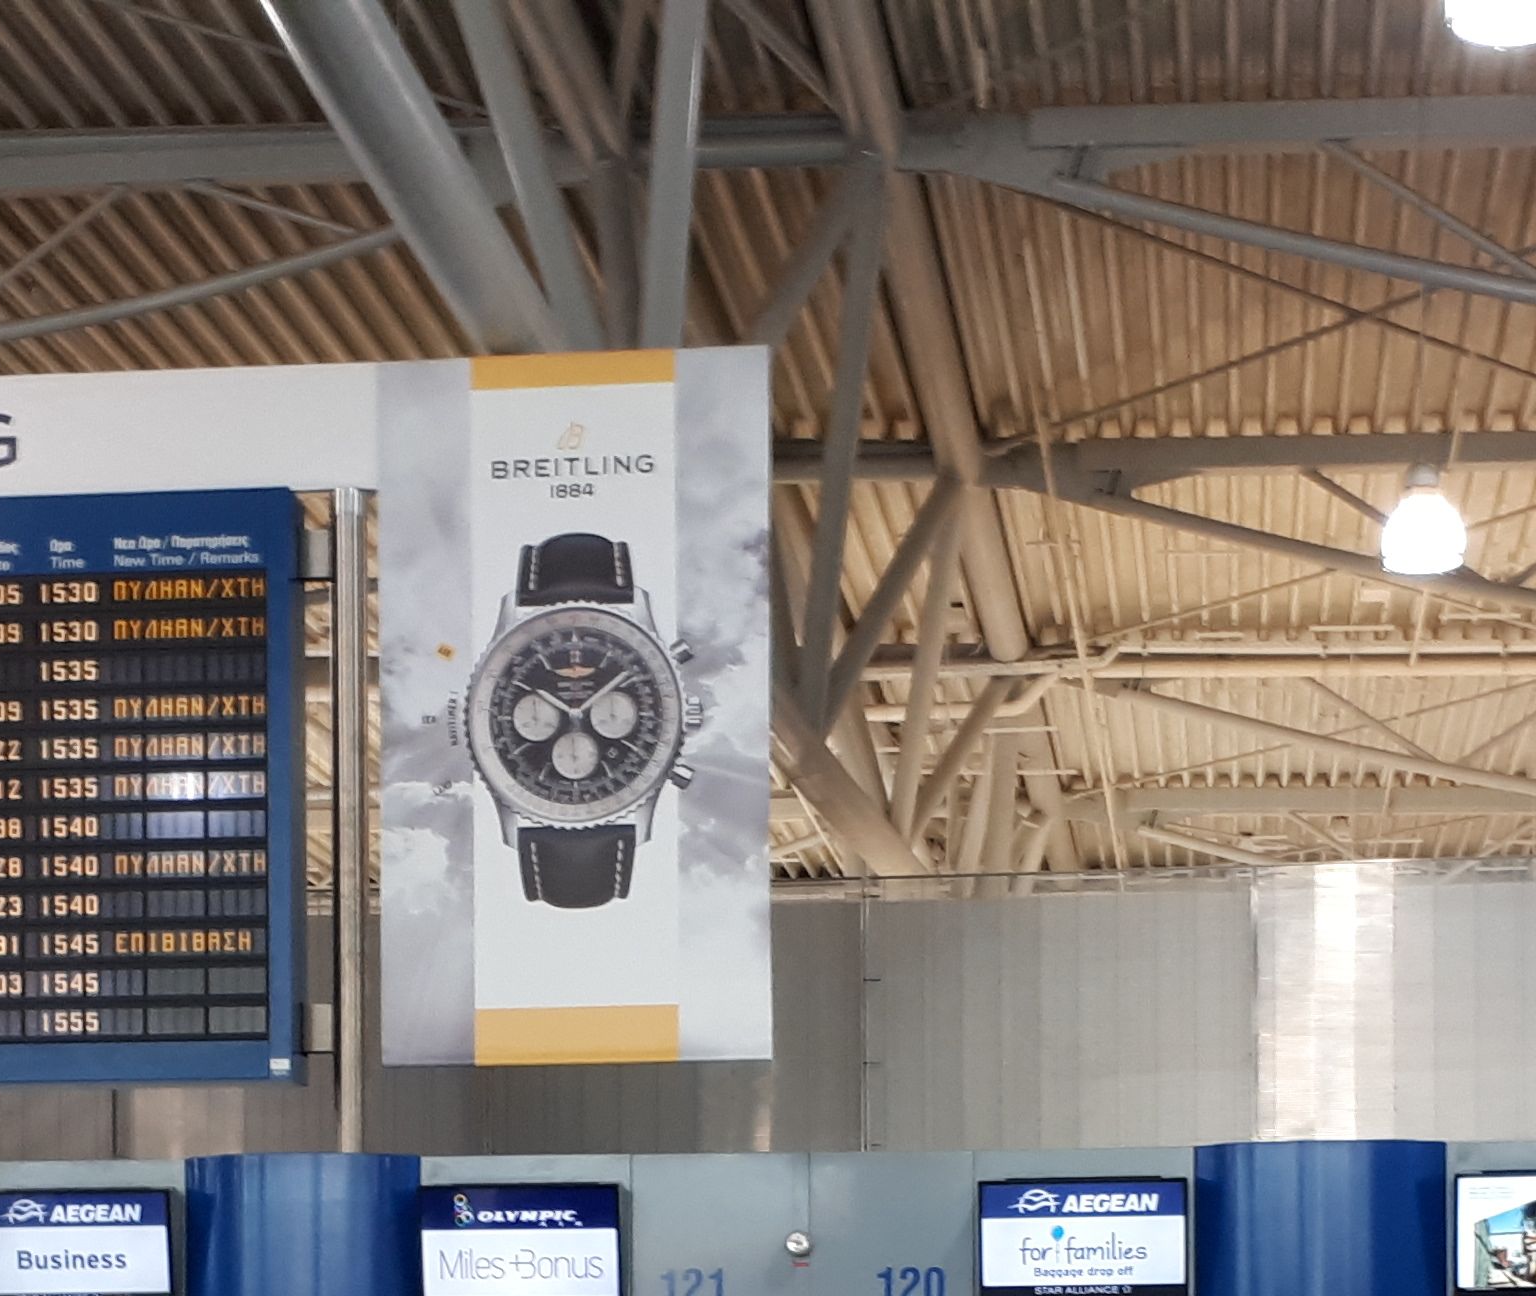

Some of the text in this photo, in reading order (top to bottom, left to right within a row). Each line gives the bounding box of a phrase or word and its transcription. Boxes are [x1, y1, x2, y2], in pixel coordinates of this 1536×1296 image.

[490, 454, 655, 480] BREITLING
[549, 481, 595, 500] 1884
[50, 556, 86, 571] Time
[150, 552, 184, 567] Time
[199, 549, 260, 566] Remarks
[41, 581, 98, 604] 1530
[41, 620, 98, 643] 1530
[41, 659, 98, 682] 1535
[41, 698, 98, 721] 1535
[41, 737, 98, 760] 1535
[41, 777, 99, 799] 1535
[41, 816, 99, 838] 1540
[41, 855, 99, 877] 1540
[41, 894, 99, 916] 1540
[41, 933, 99, 955] 1545
[41, 972, 99, 995] 1545
[42, 1011, 99, 1034] 1555
[49, 1203, 143, 1224] AEGEAN
[1061, 1193, 1160, 1213] AEGEAN
[476, 1209, 578, 1223] OLYMPIC
[16, 1248, 128, 1270] Business
[1019, 1231, 1149, 1266] for families
[1033, 1265, 1135, 1278] Baggage drop off
[1033, 1285, 1120, 1296] STAR ALLIANCE
